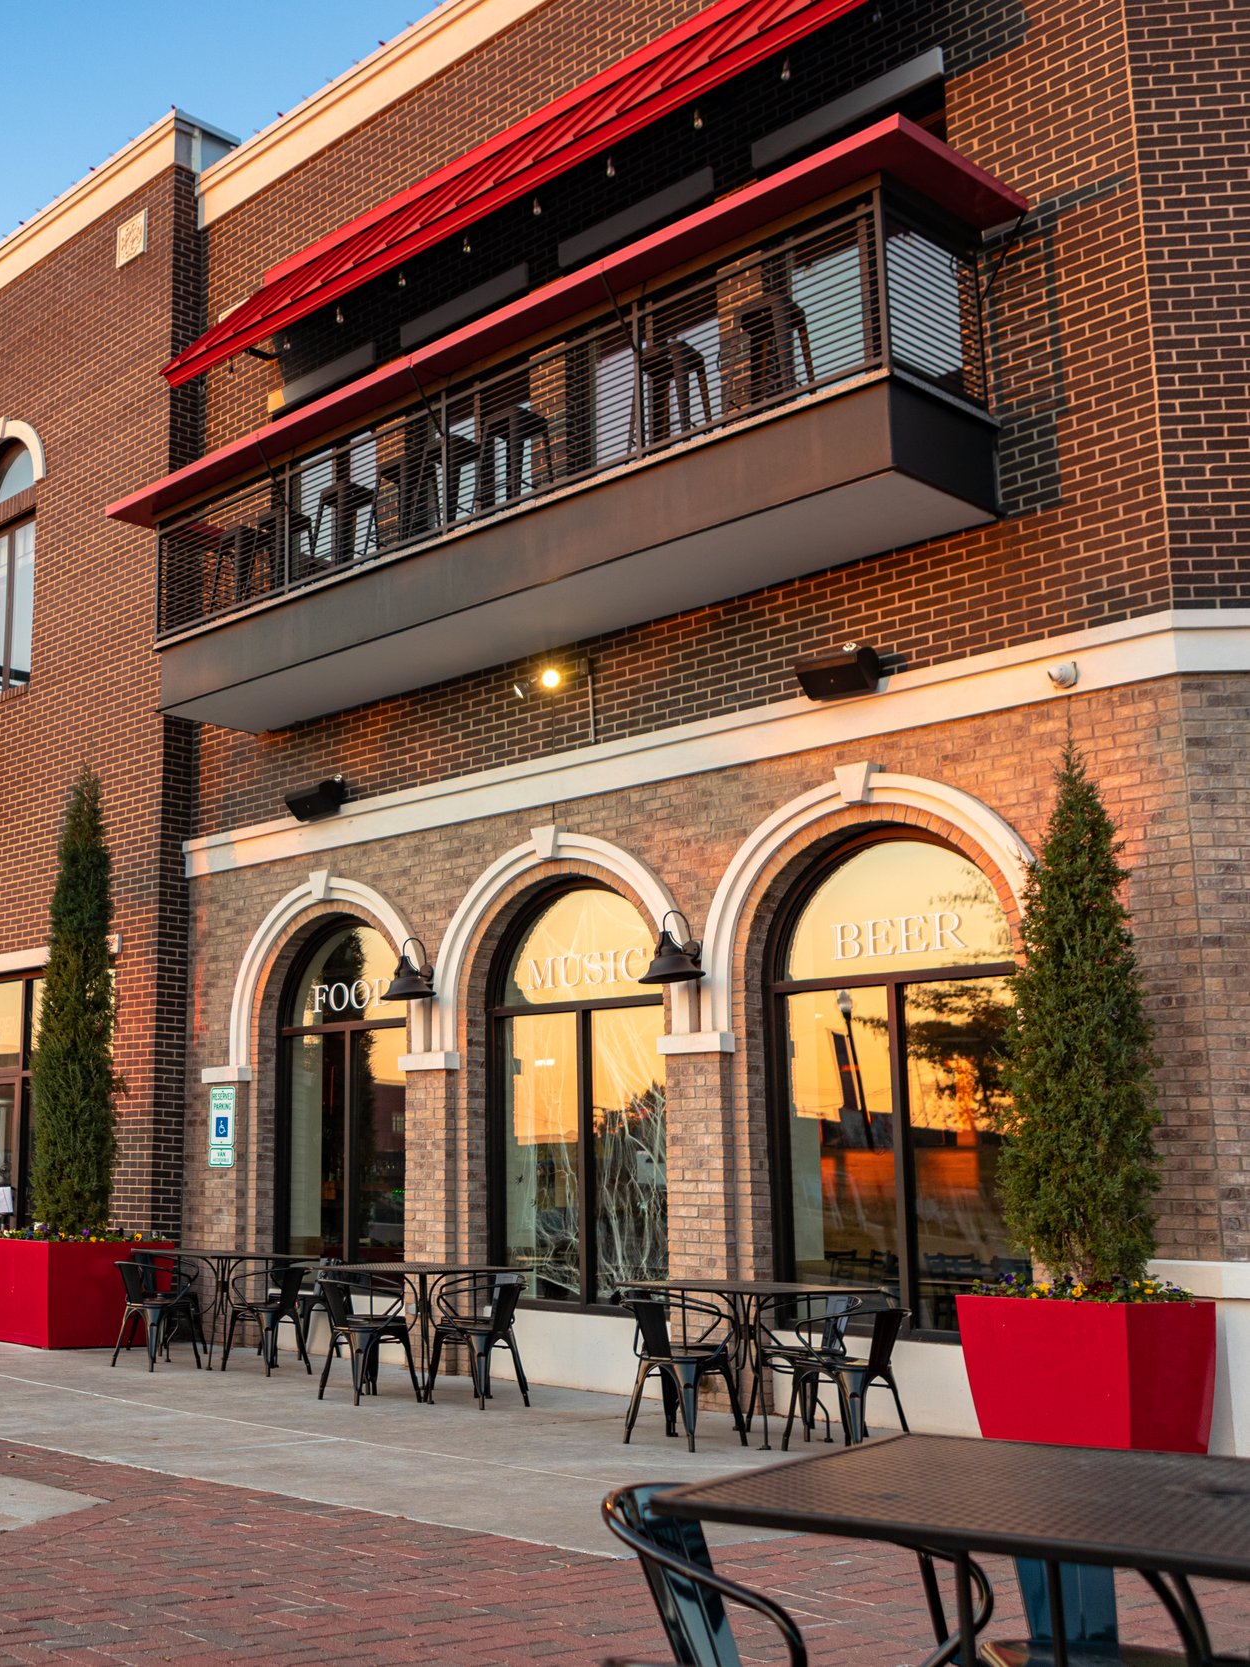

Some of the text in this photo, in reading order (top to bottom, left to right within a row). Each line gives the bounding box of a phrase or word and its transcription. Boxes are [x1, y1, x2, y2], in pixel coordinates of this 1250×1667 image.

[830, 911, 968, 961] BEER
[526, 947, 647, 991] MUSIC
[311, 978, 391, 1013] FOOD
[212, 1092, 233, 1100] RESERVED
[213, 1102, 232, 1111] PARKING
